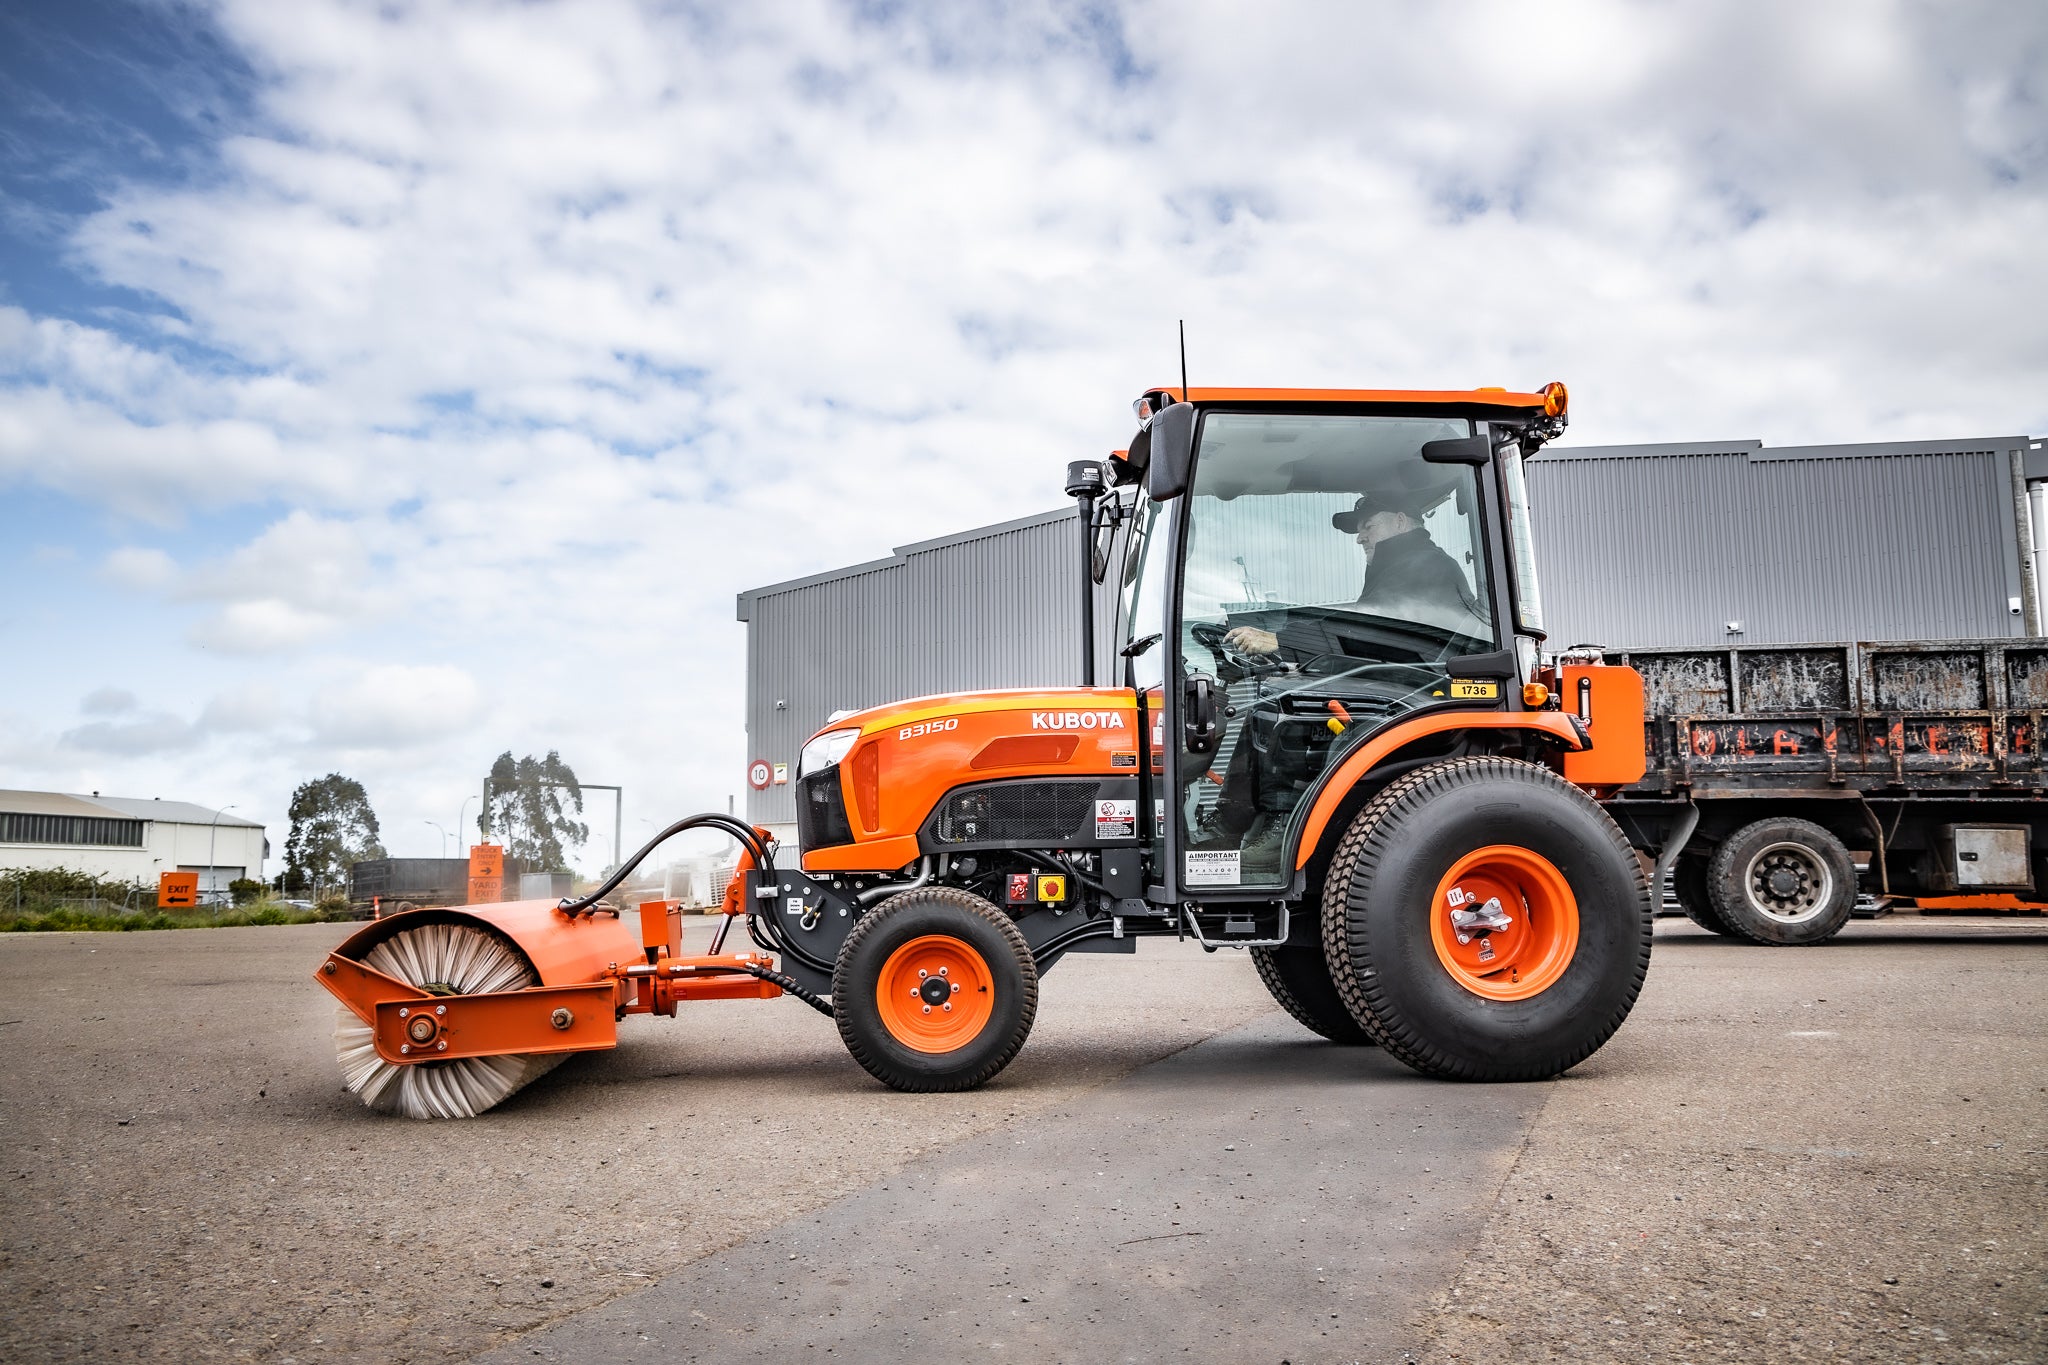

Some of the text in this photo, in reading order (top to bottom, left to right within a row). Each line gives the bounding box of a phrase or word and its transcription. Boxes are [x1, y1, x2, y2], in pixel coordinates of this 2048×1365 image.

[1462, 686, 1486, 695] 1736
[1031, 711, 1125, 730] KUBOTA
[899, 718, 959, 740] B3150
[755, 769, 765, 780] 10
